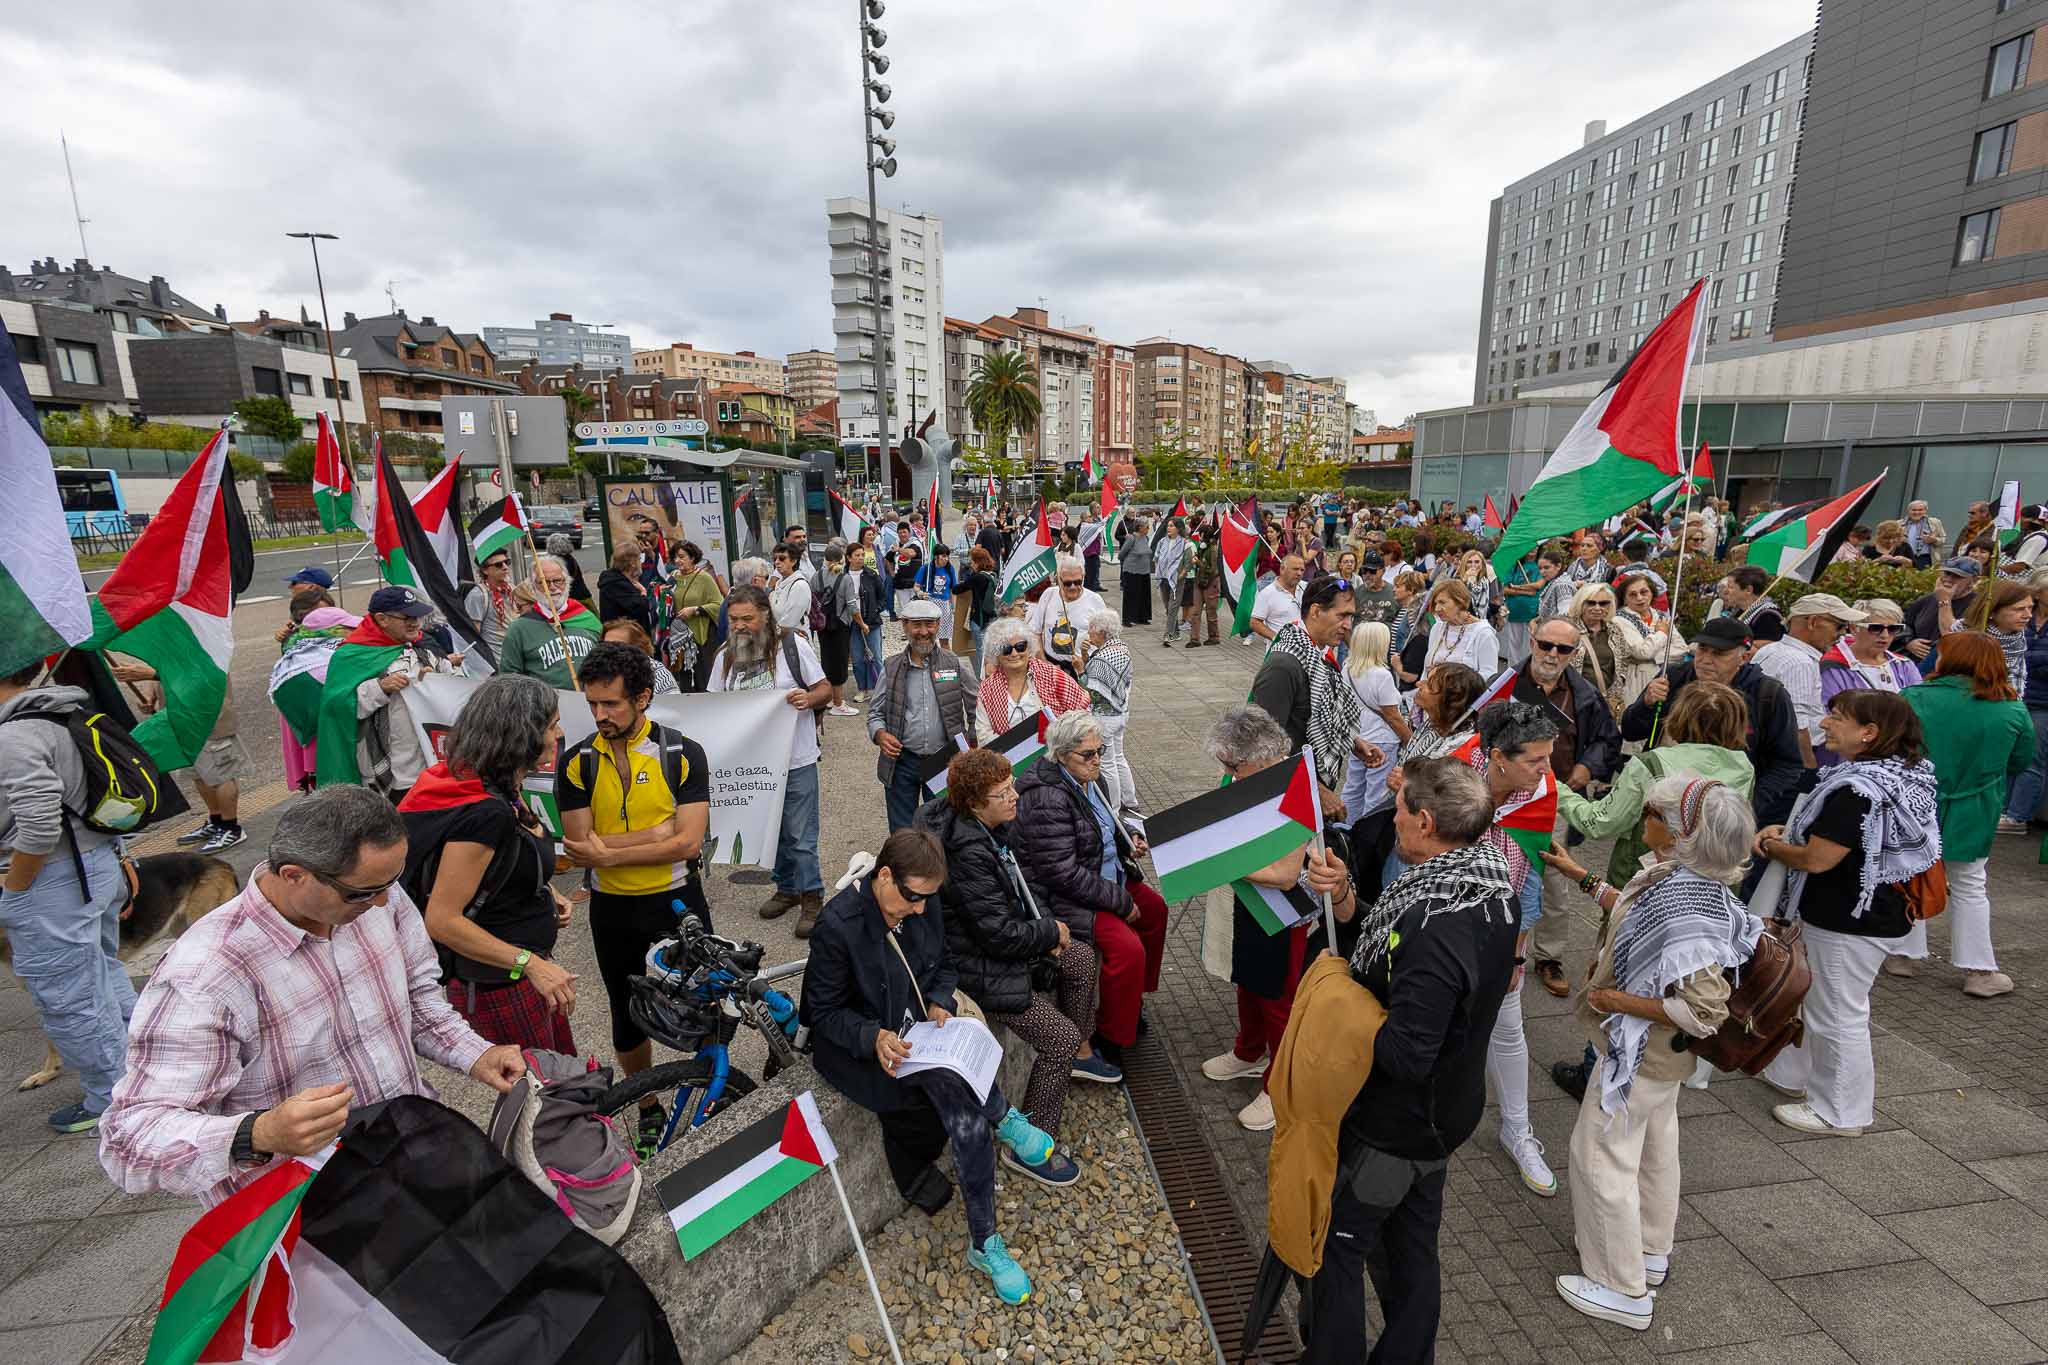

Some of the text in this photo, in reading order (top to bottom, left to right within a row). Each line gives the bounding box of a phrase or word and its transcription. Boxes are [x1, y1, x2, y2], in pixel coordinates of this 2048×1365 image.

[608, 481, 720, 507] CAUDALÍE
[715, 768, 732, 779] de
[735, 766, 773, 777] Gaza,
